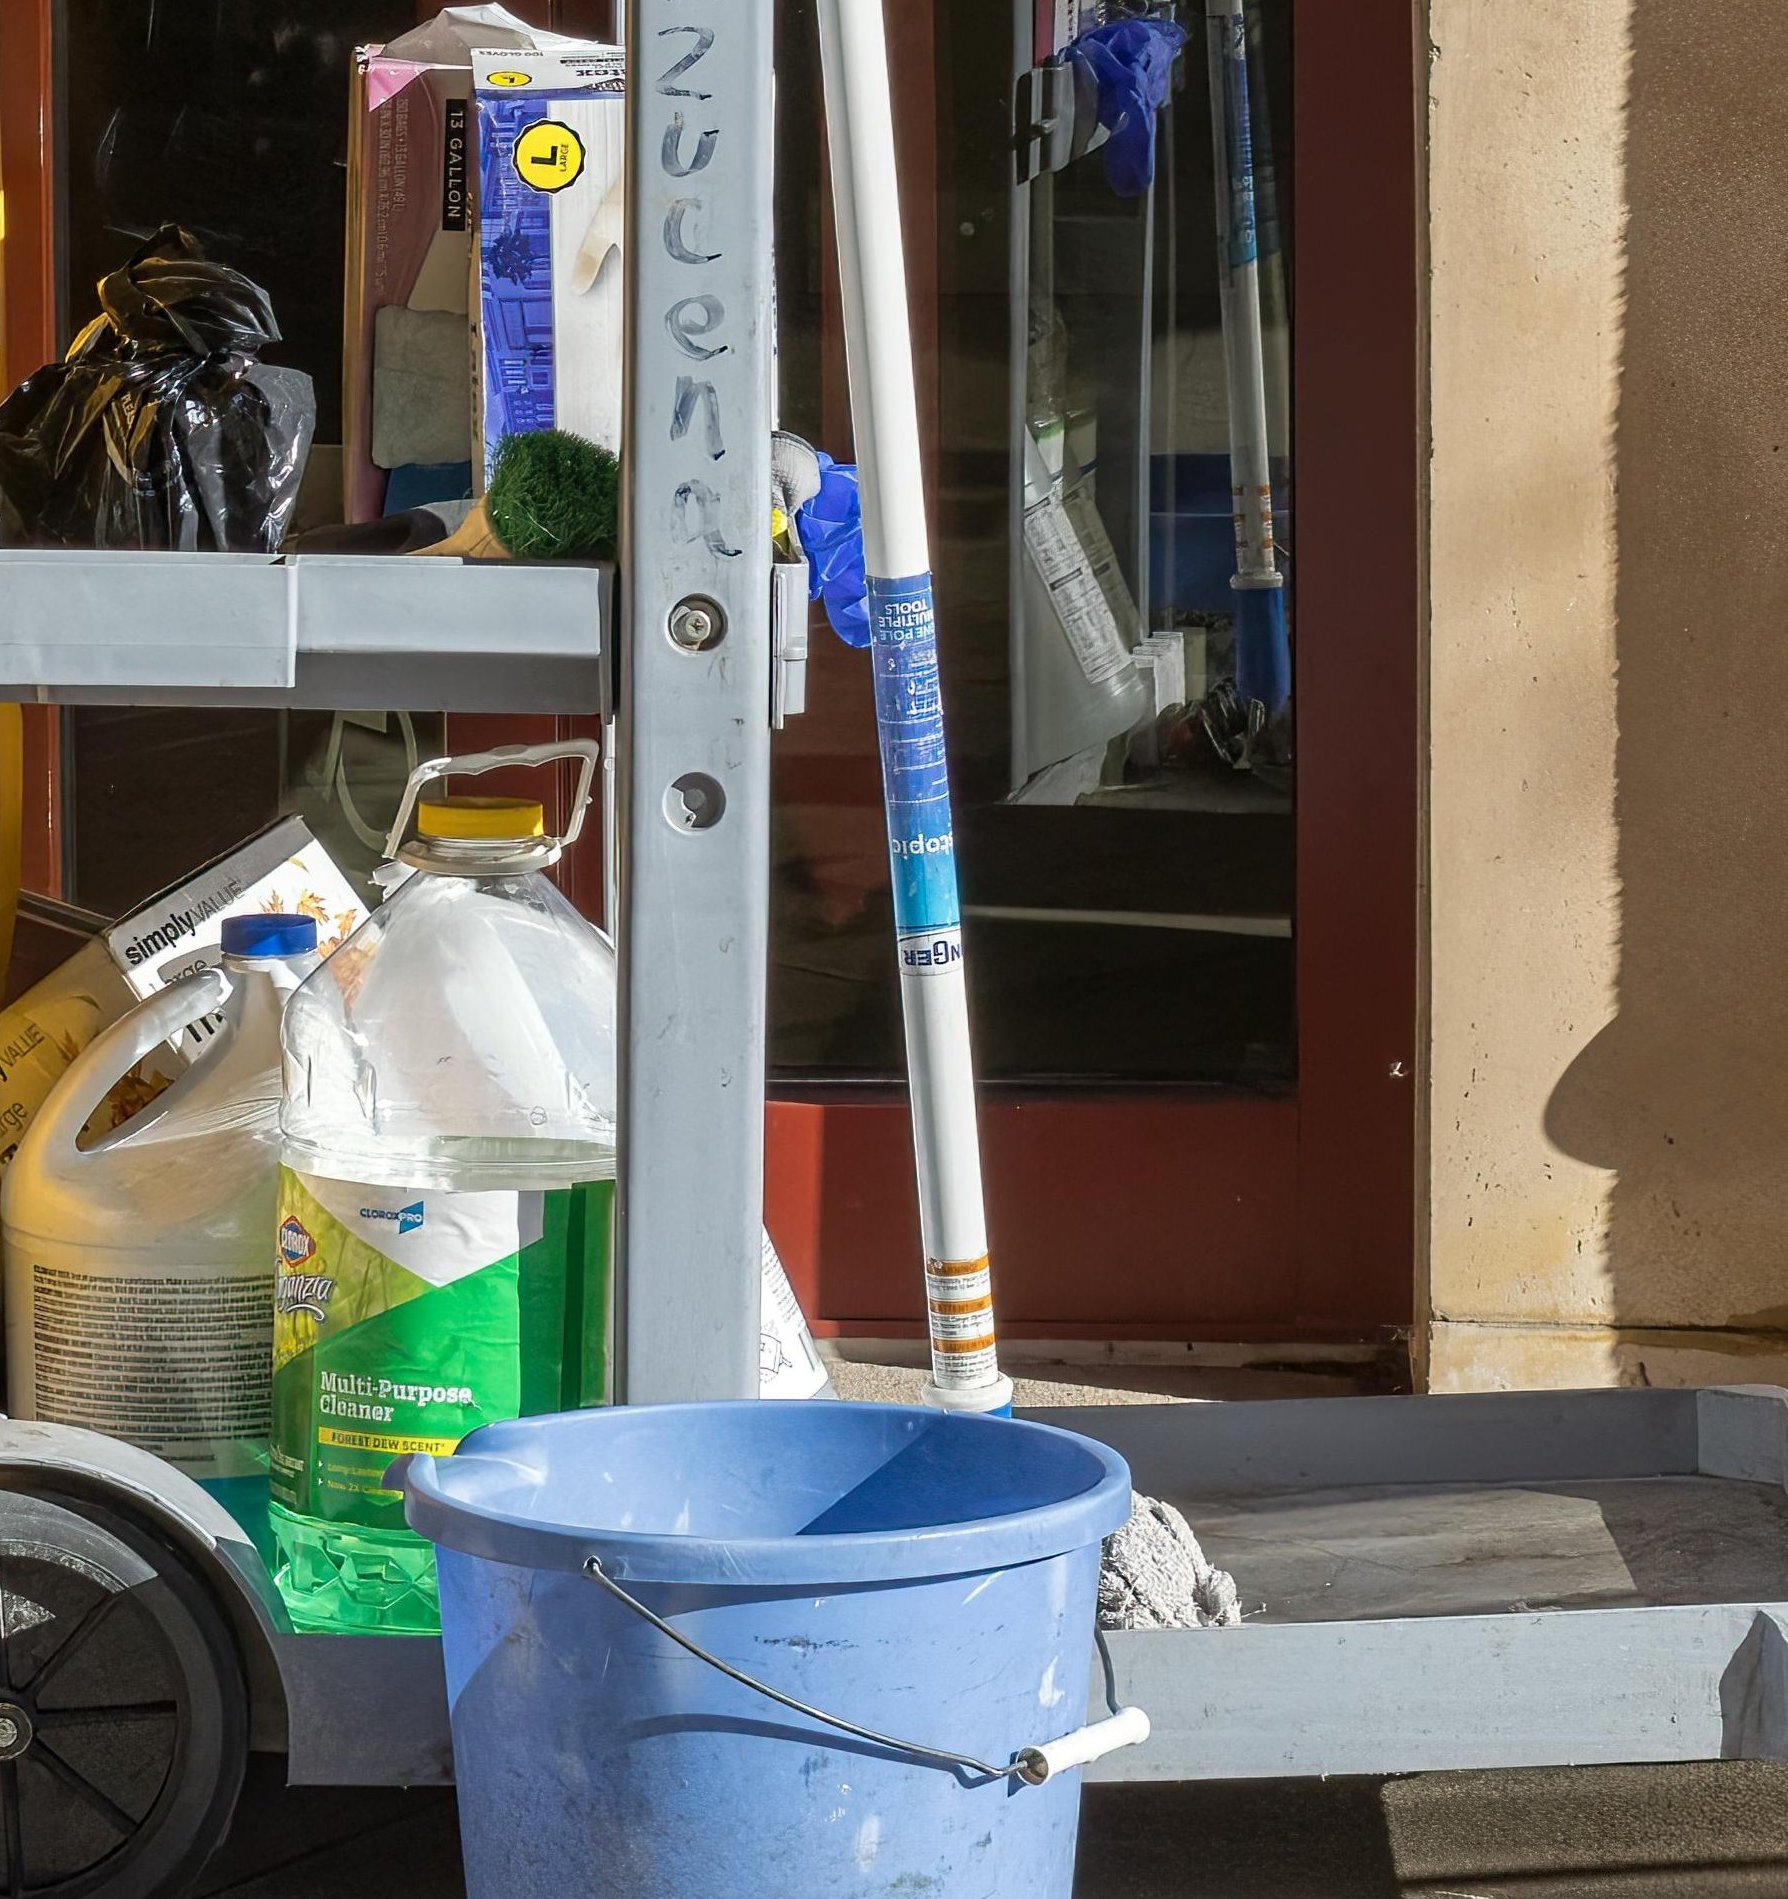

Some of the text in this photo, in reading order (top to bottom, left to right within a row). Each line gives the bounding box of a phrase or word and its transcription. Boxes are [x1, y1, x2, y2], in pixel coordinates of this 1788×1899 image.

[447, 110, 464, 218] 13 GALLON
[530, 145, 558, 166] L
[559, 144, 570, 172] LARGE
[884, 598, 928, 615] TOOLS
[879, 627, 914, 642] POLE
[319, 1371, 473, 1408] Multi-Purpose
[318, 1394, 395, 1423] Cleaner
[331, 1432, 371, 1448] FOREST
[372, 1437, 400, 1451] DEW
